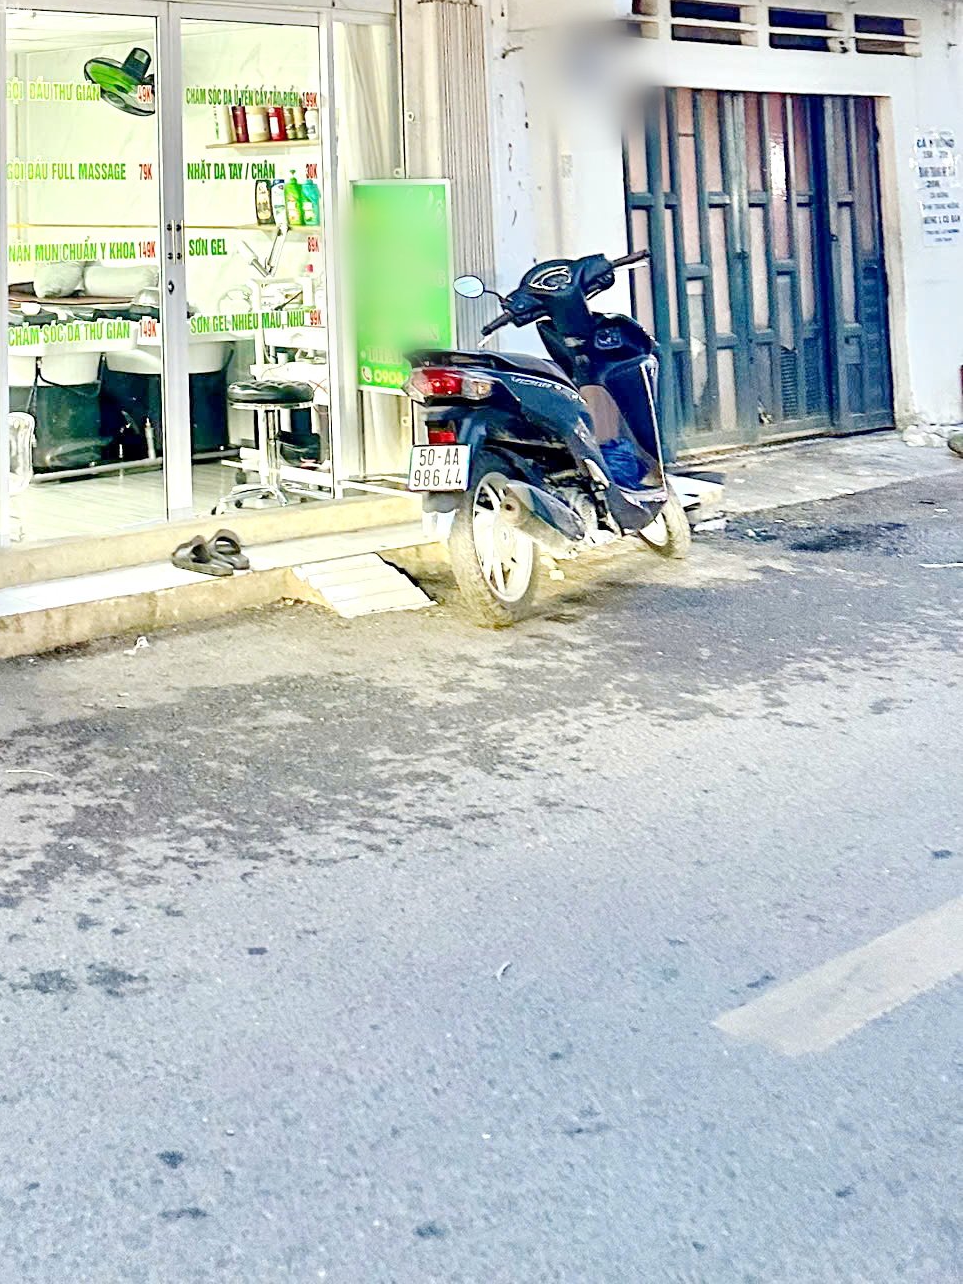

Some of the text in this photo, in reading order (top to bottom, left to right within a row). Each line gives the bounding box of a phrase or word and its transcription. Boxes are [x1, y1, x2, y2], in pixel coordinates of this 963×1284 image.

[51, 163, 75, 180] FULL
[78, 163, 126, 180] MASSAGE
[139, 164, 153, 180] 79K
[214, 163, 226, 180] DA
[228, 163, 243, 180] TAY
[251, 160, 275, 180] CHÂN
[100, 242, 106, 259] Y
[109, 242, 136, 259] KHOA
[138, 241, 156, 258] 149K
[189, 237, 208, 256] SƠN
[211, 239, 227, 255] GEL
[67, 324, 81, 342] DA
[139, 320, 157, 337] 149K
[190, 315, 210, 334] SƠN
[213, 316, 229, 332] GEL
[419, 447, 459, 467] 50-AA
